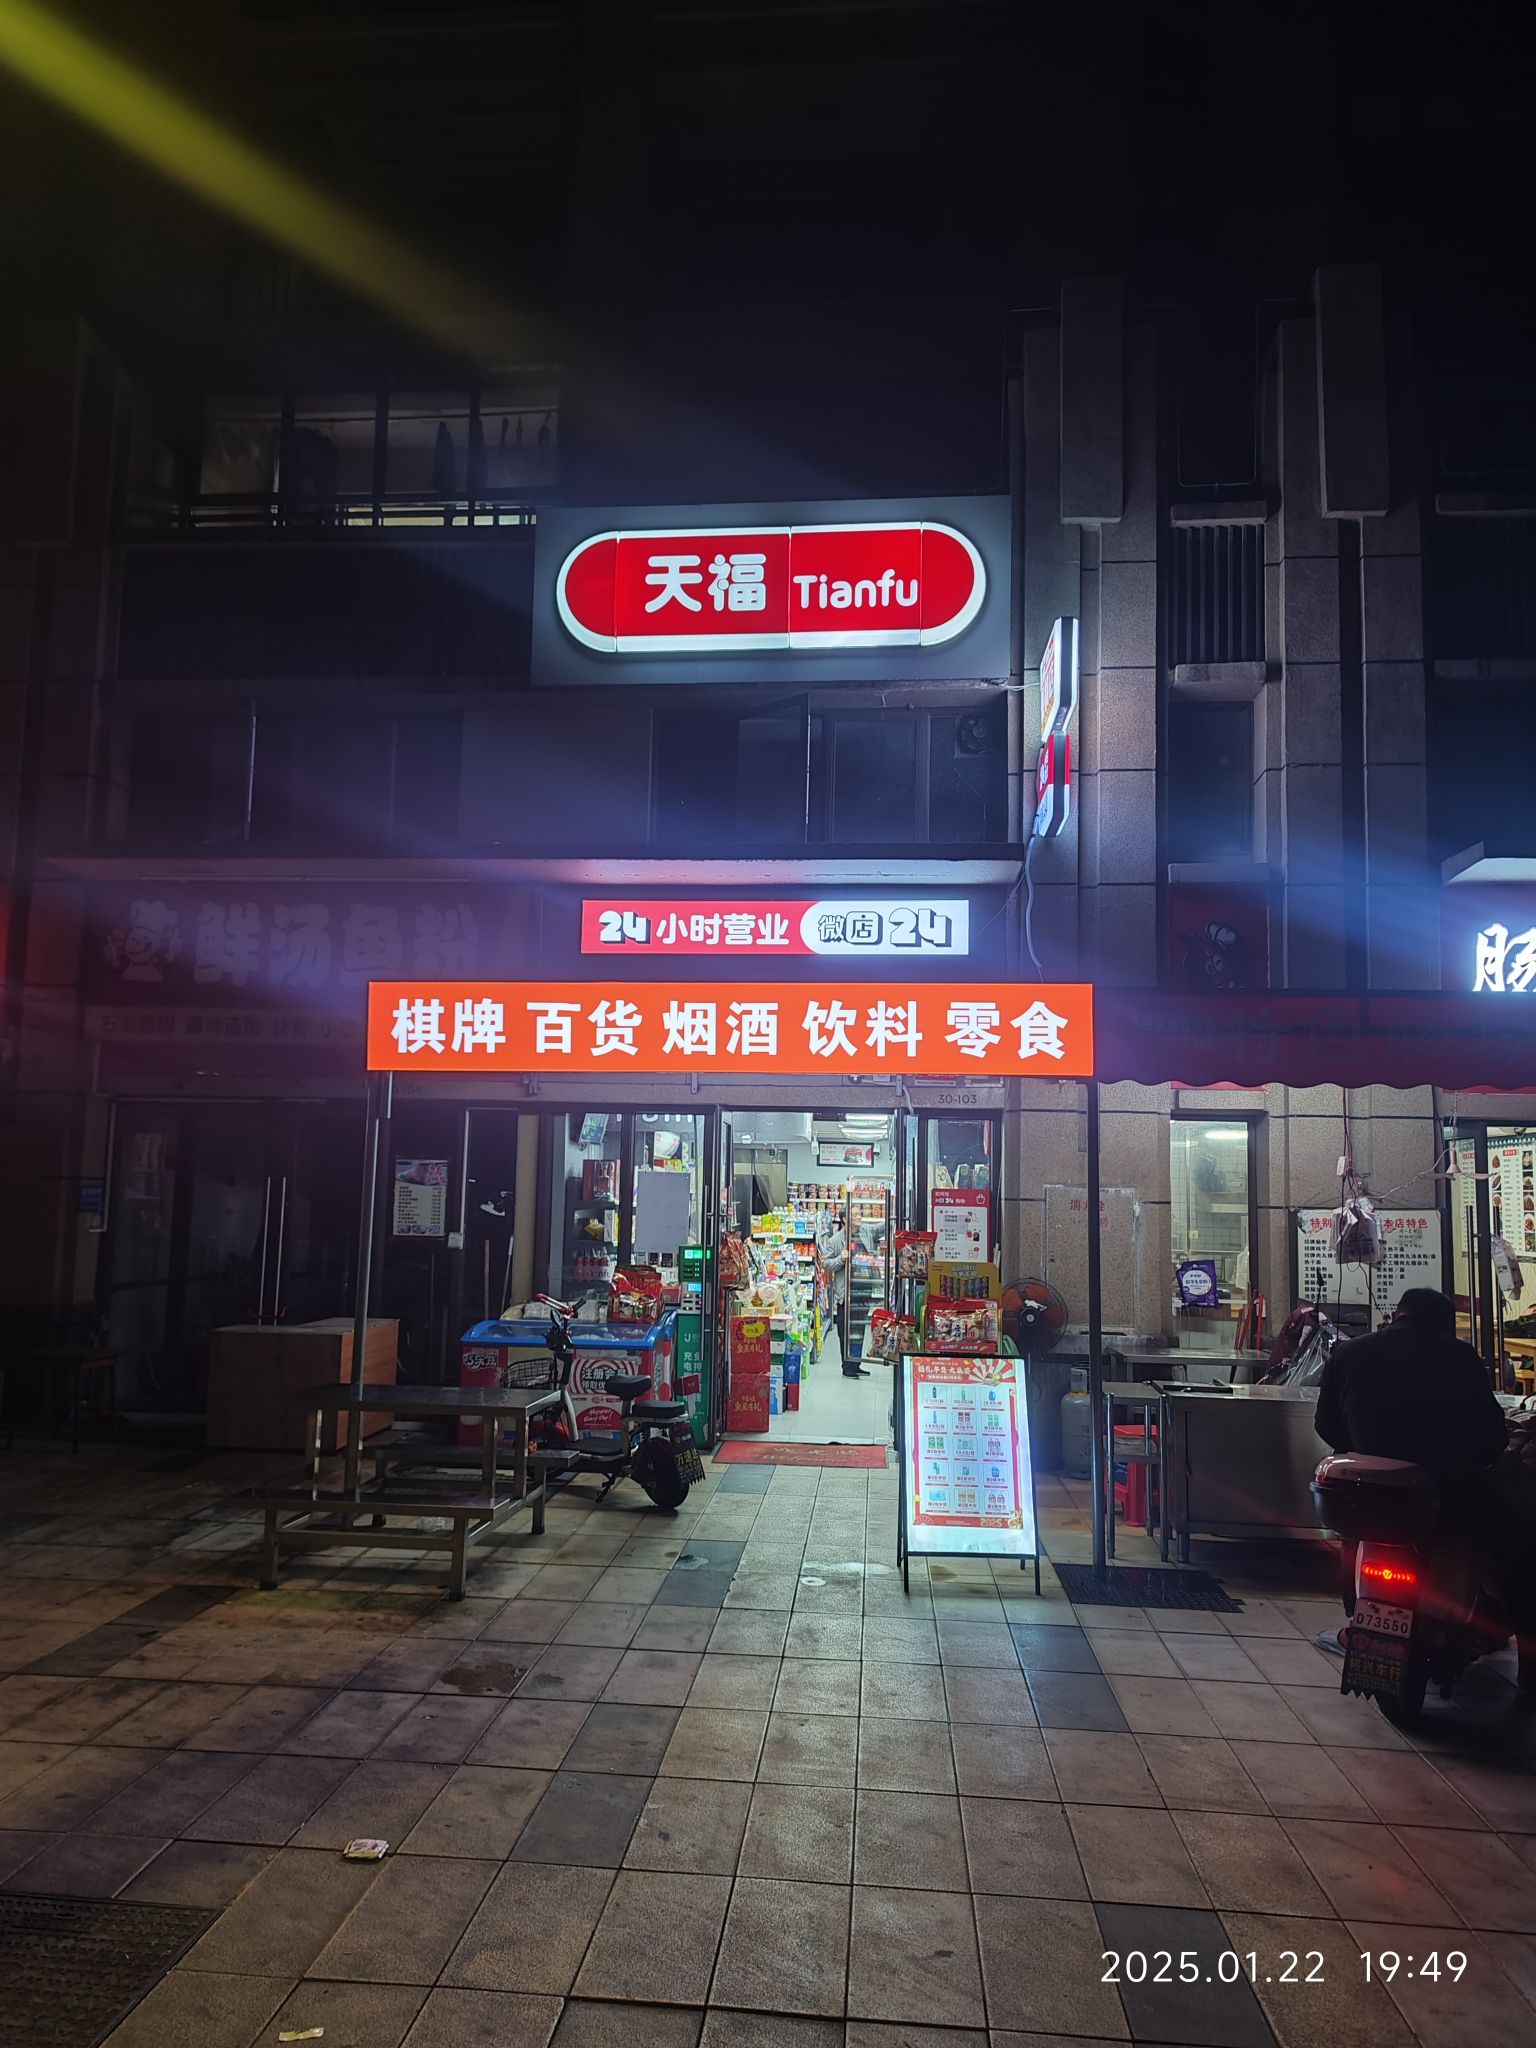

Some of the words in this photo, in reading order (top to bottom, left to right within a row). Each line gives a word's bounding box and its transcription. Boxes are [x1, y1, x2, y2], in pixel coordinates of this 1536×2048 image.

[644, 553, 767, 612] 天福
[793, 569, 918, 609] Tianfu
[193, 902, 480, 988] 鲜汤鱼粉
[598, 911, 789, 946] 24小时营业
[390, 998, 507, 1054] 棋牌
[527, 1000, 643, 1057] 百货
[662, 1000, 779, 1057] 烟酒
[802, 1000, 924, 1058] 饮料
[945, 1000, 1069, 1059] 零食
[938, 1094, 977, 1104] 30-103
[1383, 1218, 1428, 1229] 本店特色
[980, 1517, 1003, 1528] 2025
[1357, 1613, 1409, 1634] D73550
